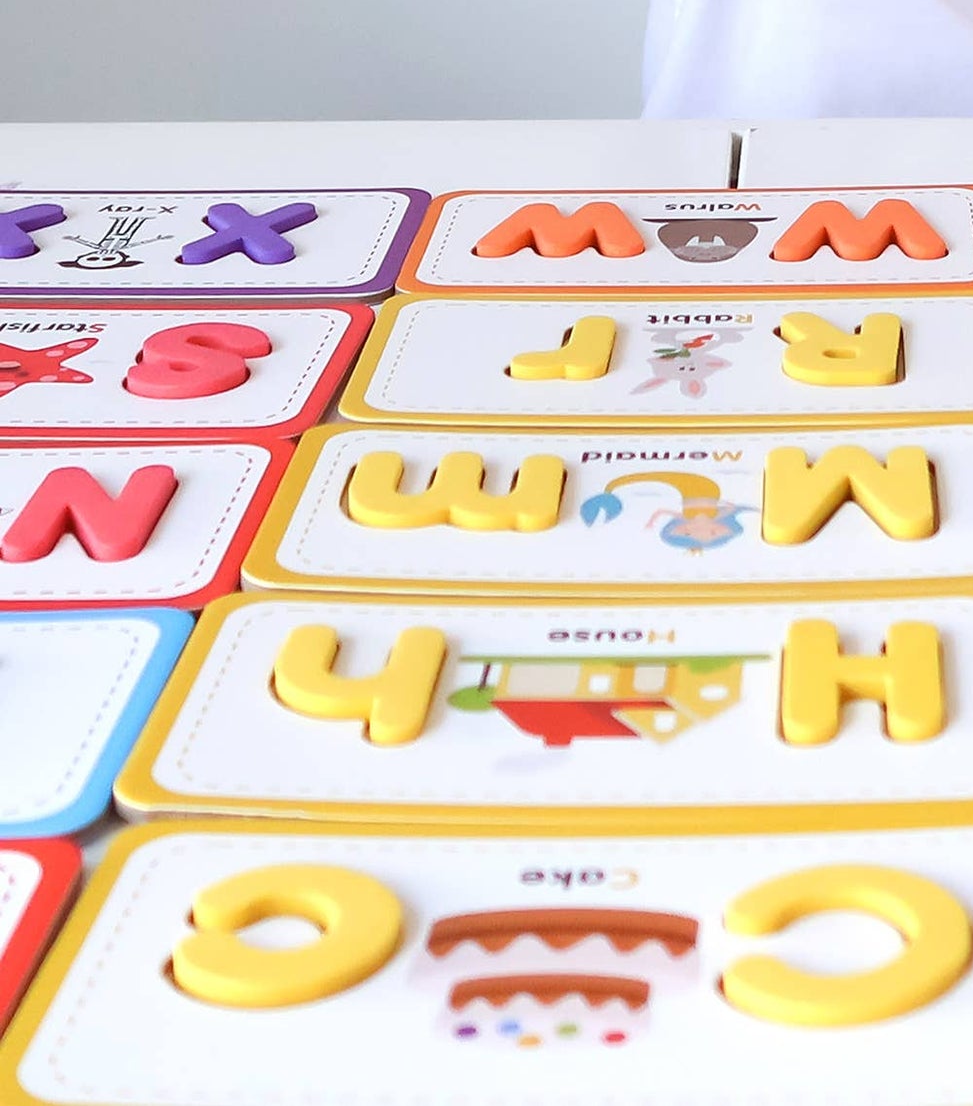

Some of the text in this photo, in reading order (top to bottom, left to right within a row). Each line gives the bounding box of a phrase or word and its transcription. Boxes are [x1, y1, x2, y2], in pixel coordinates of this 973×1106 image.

[98, 204, 177, 214] X-ray
[176, 203, 318, 265] X
[665, 203, 761, 212] Walrus
[769, 199, 949, 262] W
[505, 317, 618, 381] r
[647, 314, 753, 325] Rabbit
[774, 313, 905, 386] R
[122, 322, 273, 399] S
[581, 450, 743, 463] Mermaid
[0, 465, 179, 563] N
[340, 452, 568, 532] m
[762, 446, 941, 545] M
[548, 628, 676, 643] House
[269, 626, 450, 745] h
[778, 620, 949, 746] H
[519, 868, 639, 890] Cake
